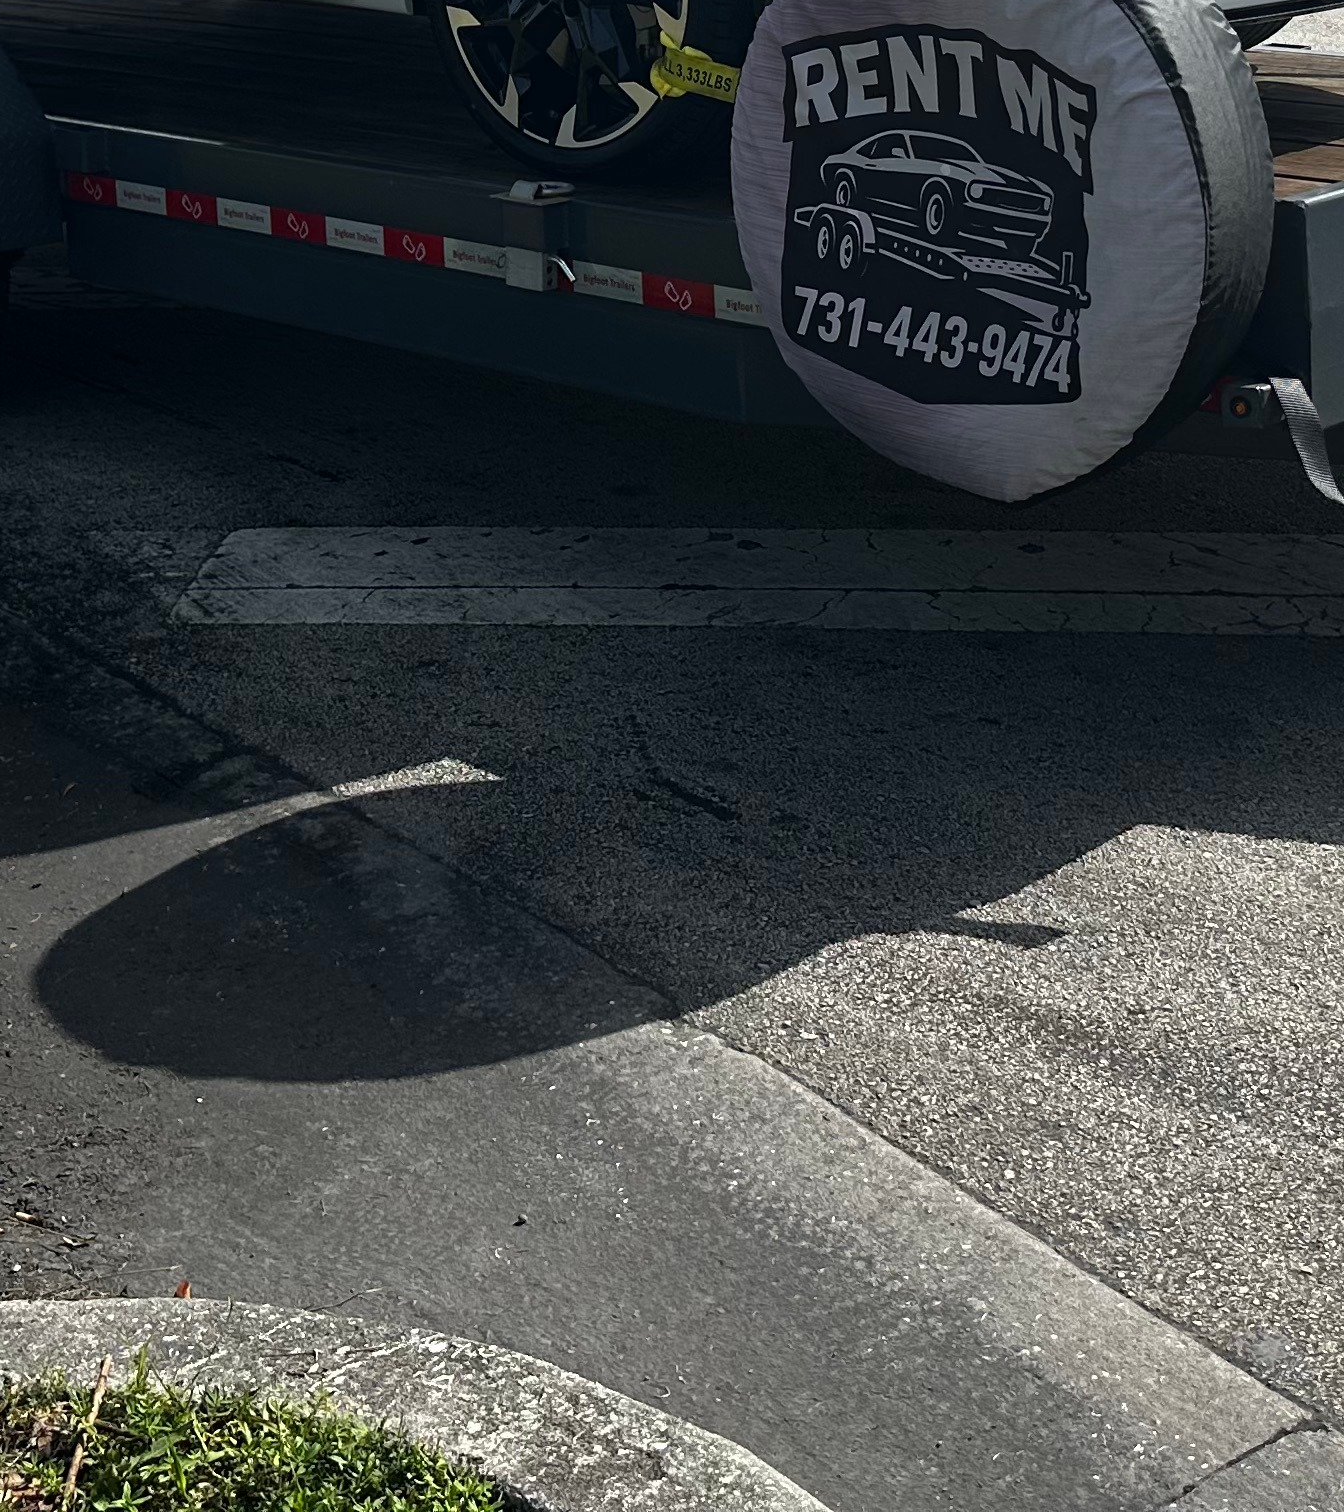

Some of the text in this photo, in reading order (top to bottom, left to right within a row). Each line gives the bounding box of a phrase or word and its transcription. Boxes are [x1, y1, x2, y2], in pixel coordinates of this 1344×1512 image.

[675, 63, 733, 93] 3,333LBS
[790, 35, 1089, 177] RENT ME
[334, 227, 378, 245] Bigfoot Trailers
[583, 273, 636, 292] Bigfoot Trailers
[725, 298, 754, 313] Bigfoot
[794, 286, 1073, 393] 731-443-9474
